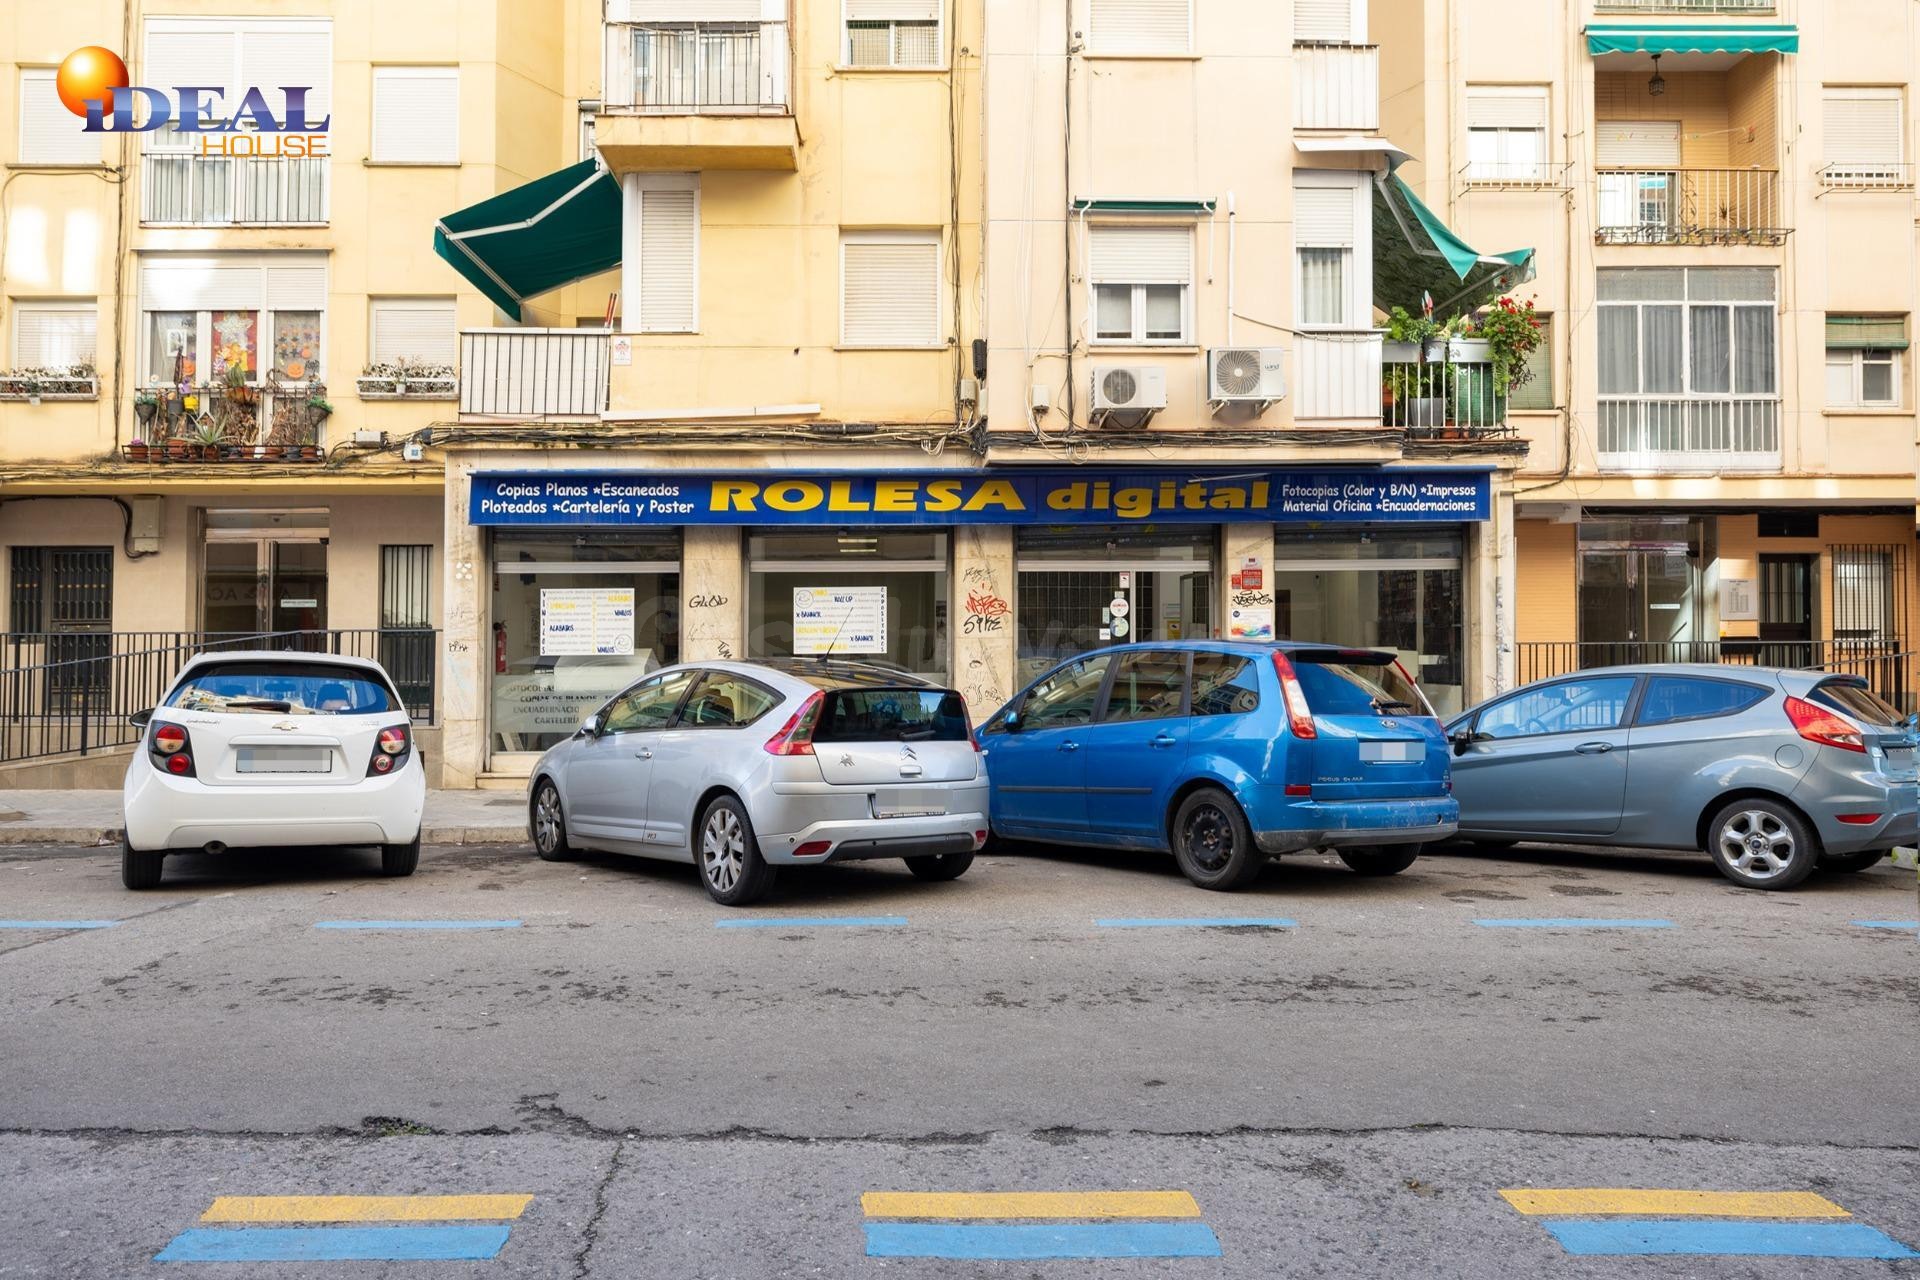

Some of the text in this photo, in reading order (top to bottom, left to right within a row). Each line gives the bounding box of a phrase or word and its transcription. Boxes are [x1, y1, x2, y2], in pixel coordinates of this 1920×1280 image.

[497, 484, 541, 499] Copias
[546, 483, 588, 496] Planos
[709, 480, 1271, 518] ROLESA digital
[1282, 484, 1339, 499] Fotocopias
[1343, 484, 1375, 498] (Color
[1379, 487, 1386, 499] y
[1390, 484, 1417, 498] B/N)
[481, 500, 547, 513] Ploteados
[636, 504, 645, 517] y
[650, 500, 695, 514] Poster
[1283, 500, 1329, 512] Material
[1333, 500, 1372, 512] Oficina
